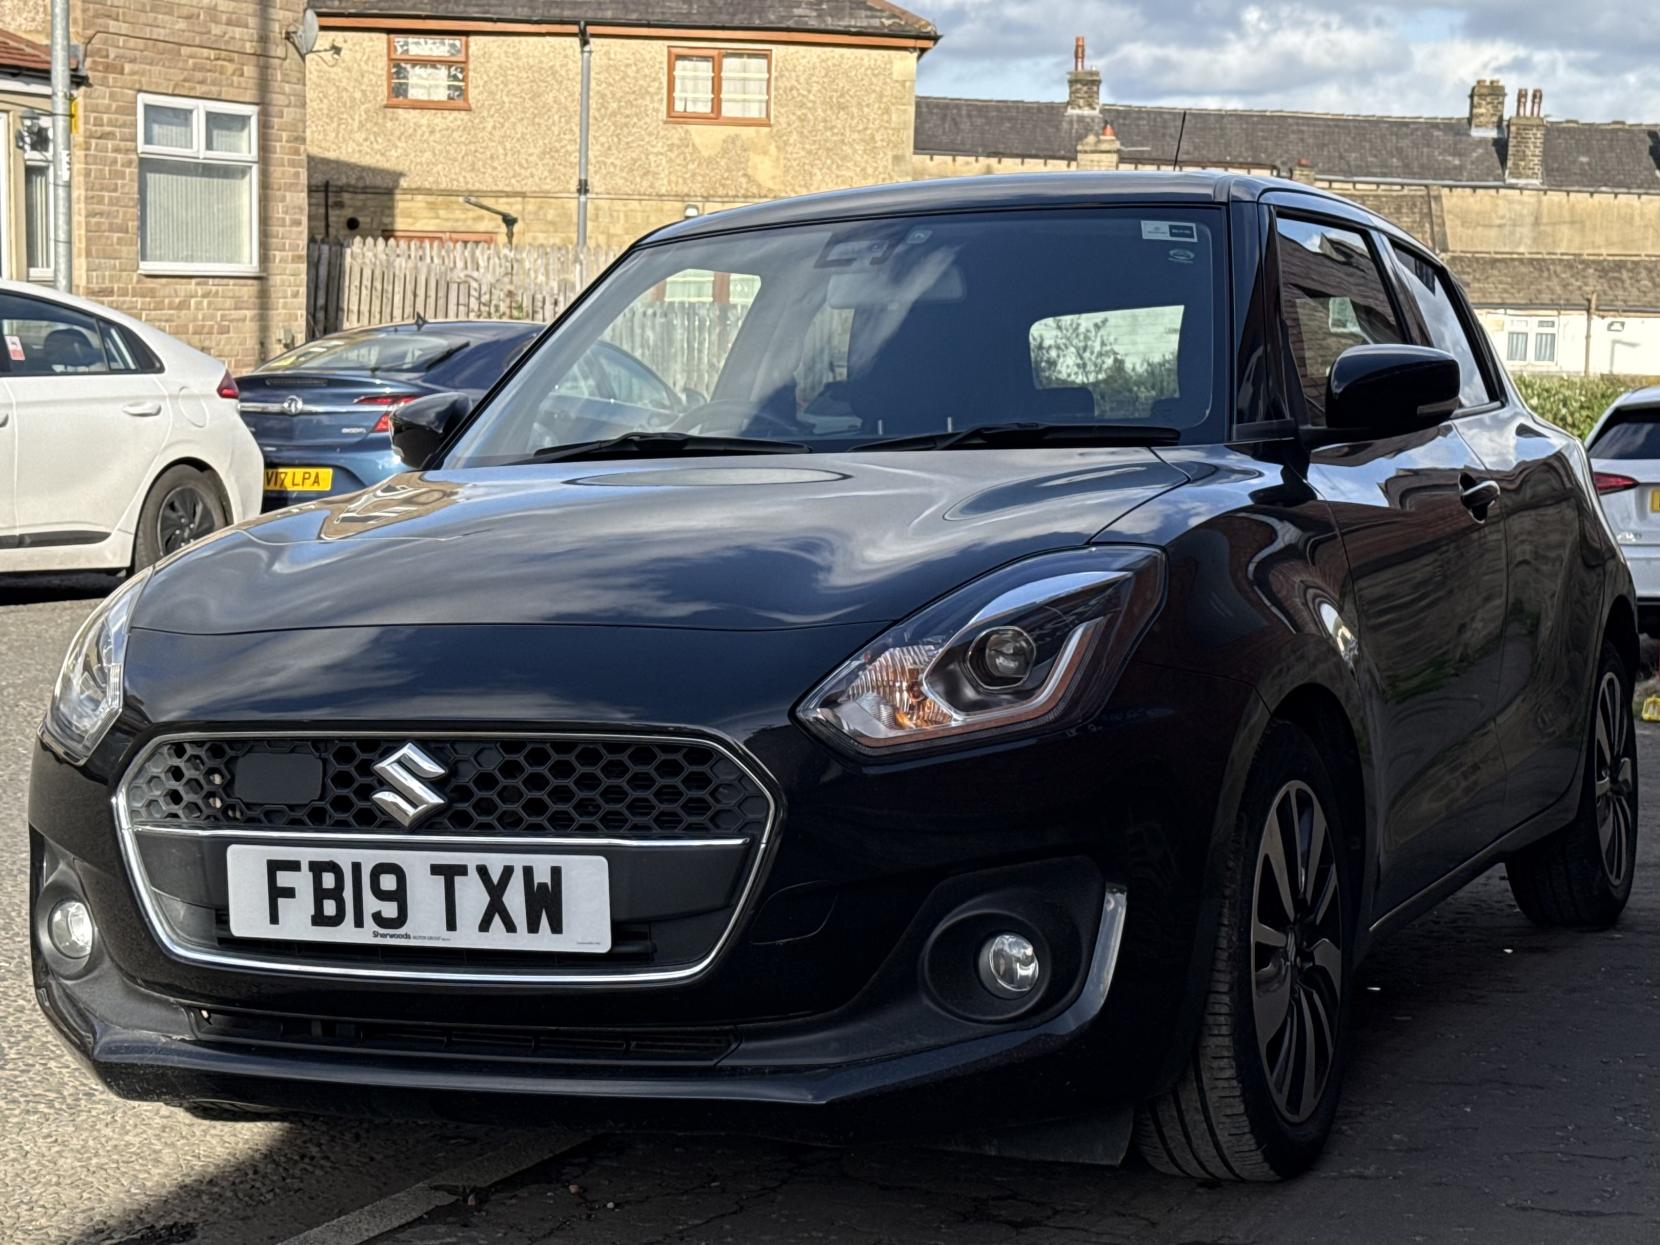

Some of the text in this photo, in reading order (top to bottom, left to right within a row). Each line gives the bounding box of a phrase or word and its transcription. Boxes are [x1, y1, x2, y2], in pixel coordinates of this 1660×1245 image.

[292, 471, 321, 487] LPA
[266, 859, 563, 934] FB19 TXW
[372, 930, 411, 940] Sherwoods
